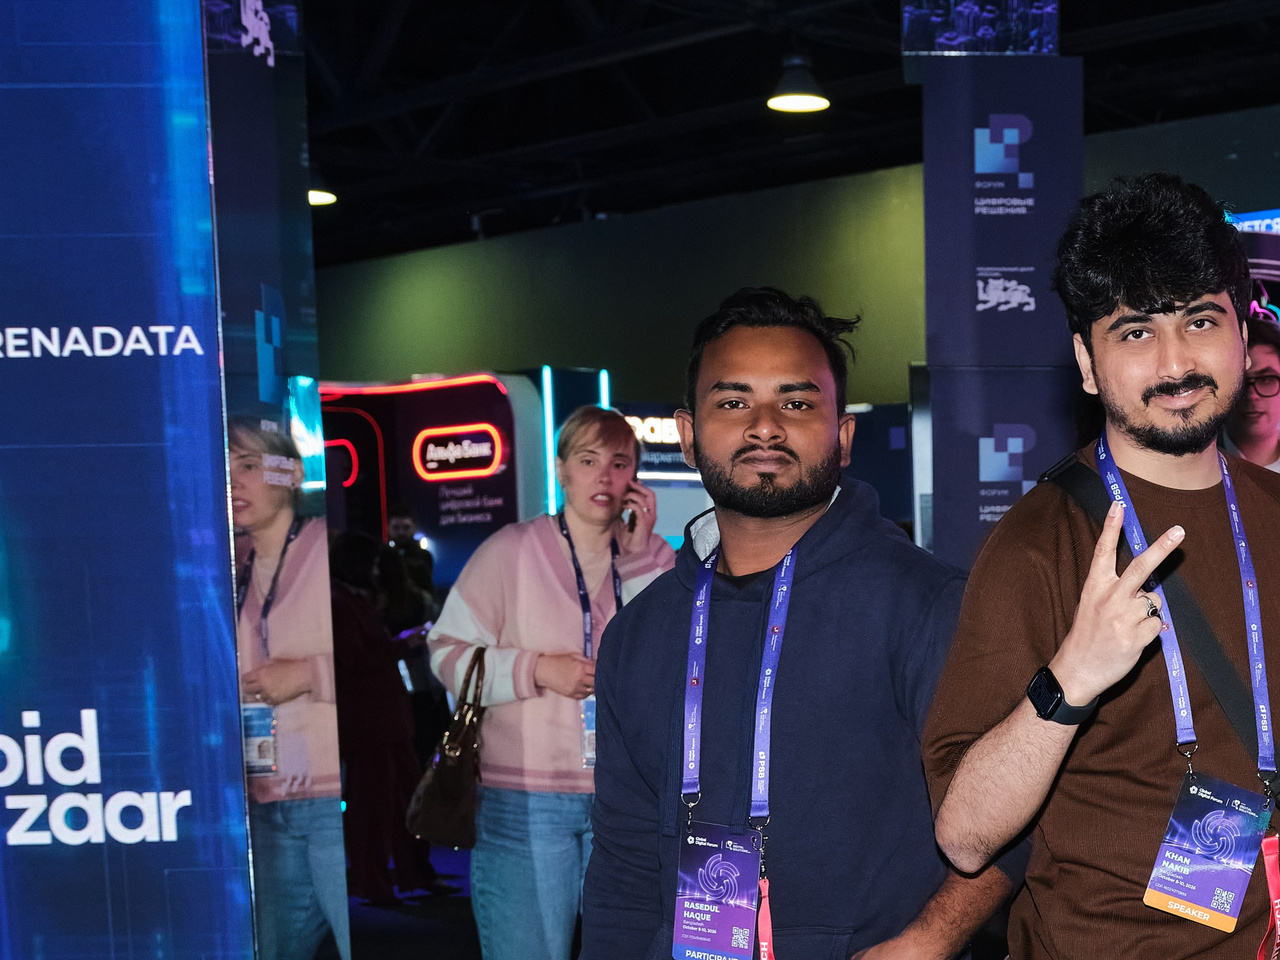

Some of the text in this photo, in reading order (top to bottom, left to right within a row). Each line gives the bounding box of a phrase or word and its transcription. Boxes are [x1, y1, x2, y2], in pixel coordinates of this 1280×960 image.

[974, 197, 1035, 207] ЦИФРОВЫЕ
[974, 206, 1028, 216] РЕШЕНИЯ
[0, 325, 205, 358] ENADATA
[5, 789, 192, 846] zaar
[1164, 850, 1191, 865] KHAN
[1162, 859, 1190, 875] NAKIB
[1157, 873, 1175, 885] October
[684, 901, 720, 913] RASEDUL
[1167, 900, 1210, 922] SPEAKER
[683, 910, 712, 922] HAQUE
[682, 924, 699, 932] October
